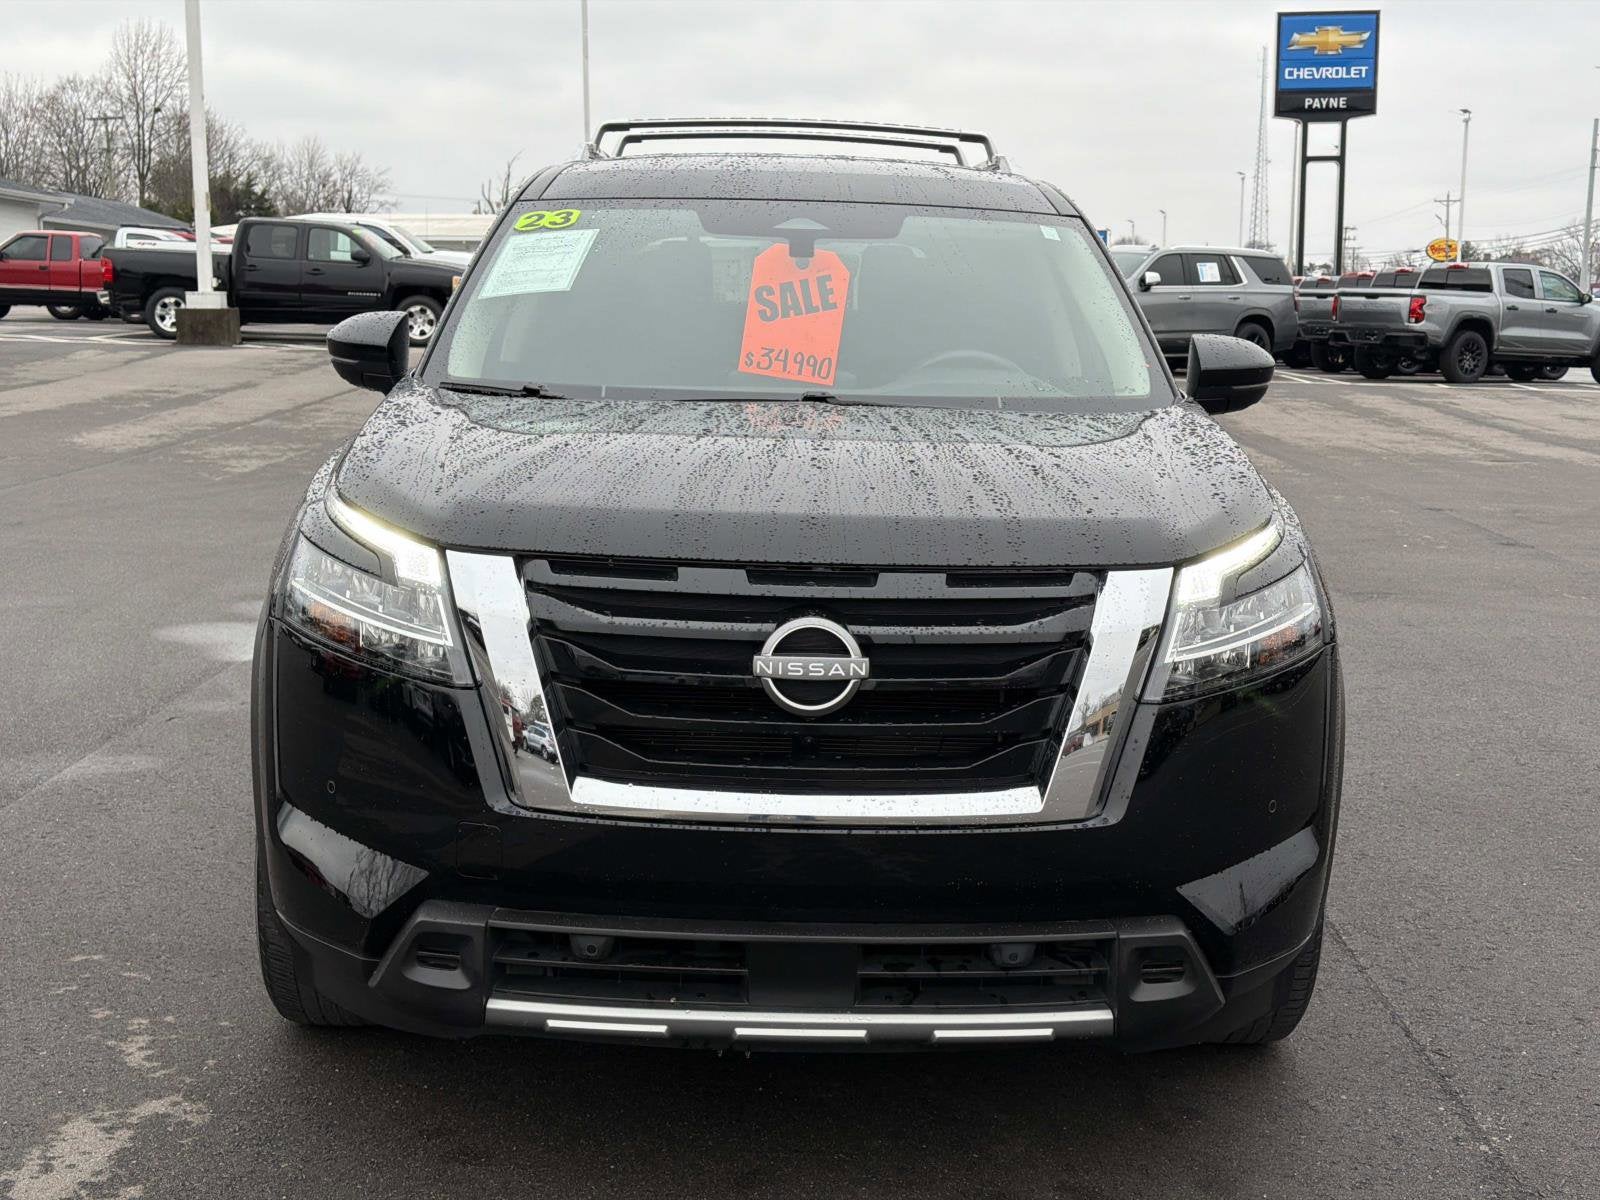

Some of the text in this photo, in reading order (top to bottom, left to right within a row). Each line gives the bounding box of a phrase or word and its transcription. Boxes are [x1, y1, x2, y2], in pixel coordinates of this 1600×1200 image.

[1284, 66, 1368, 79] CHEVROLET
[1304, 97, 1347, 109] PAYNE
[518, 210, 577, 229] 23
[754, 274, 838, 322] SALE
[756, 660, 866, 676] NISSAN
